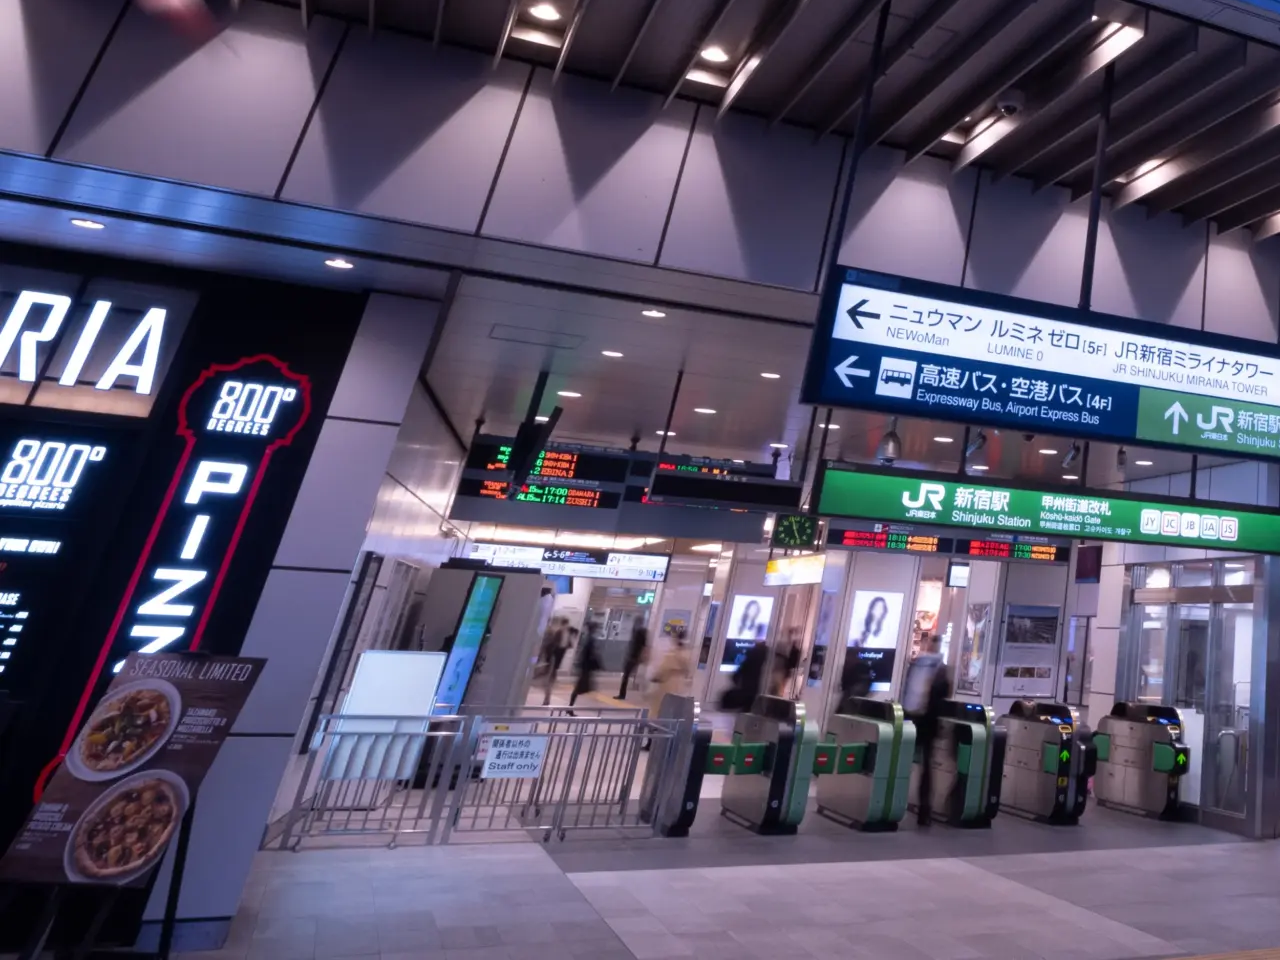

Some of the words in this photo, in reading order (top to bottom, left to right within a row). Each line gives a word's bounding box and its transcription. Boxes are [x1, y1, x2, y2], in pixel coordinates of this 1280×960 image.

[889, 304, 982, 332] ニュウマン
[1114, 341, 1274, 380] JR新宿ミライナタワー
[886, 326, 950, 347] NEWoMan
[987, 342, 1034, 360] LUMINE
[1112, 363, 1128, 375] JR
[1130, 365, 1184, 384] SHINJUKU
[1186, 374, 1230, 390] MIRAINA
[1231, 381, 1268, 397] TOWER
[918, 364, 1083, 406] 高速バス・空港バス
[916, 389, 979, 411] Expressway
[981, 397, 1003, 414] Bus,
[1005, 401, 1038, 417] Airport
[1041, 405, 1079, 422] Express
[1081, 411, 1100, 425] Bus
[1196, 405, 1235, 433] JR
[206, 418, 271, 436] DEGREES
[1236, 432, 1276, 450] Shinjuku
[902, 482, 946, 511] JR
[953, 486, 1011, 512] 新宿駅
[1041, 495, 1112, 516] 甲州街道改札
[951, 510, 995, 526] Shinjuku
[997, 514, 1032, 528] Station
[1084, 515, 1101, 525] Gate
[1145, 516, 1156, 527] JY
[1165, 518, 1176, 529] JC
[1184, 520, 1195, 531] JB
[1204, 521, 1215, 532] JA
[1223, 523, 1233, 534] JS
[130, 658, 194, 680] SEASONAL
[198, 661, 253, 682] LIMITED
[488, 761, 514, 771] Staff
[516, 761, 539, 772] only
